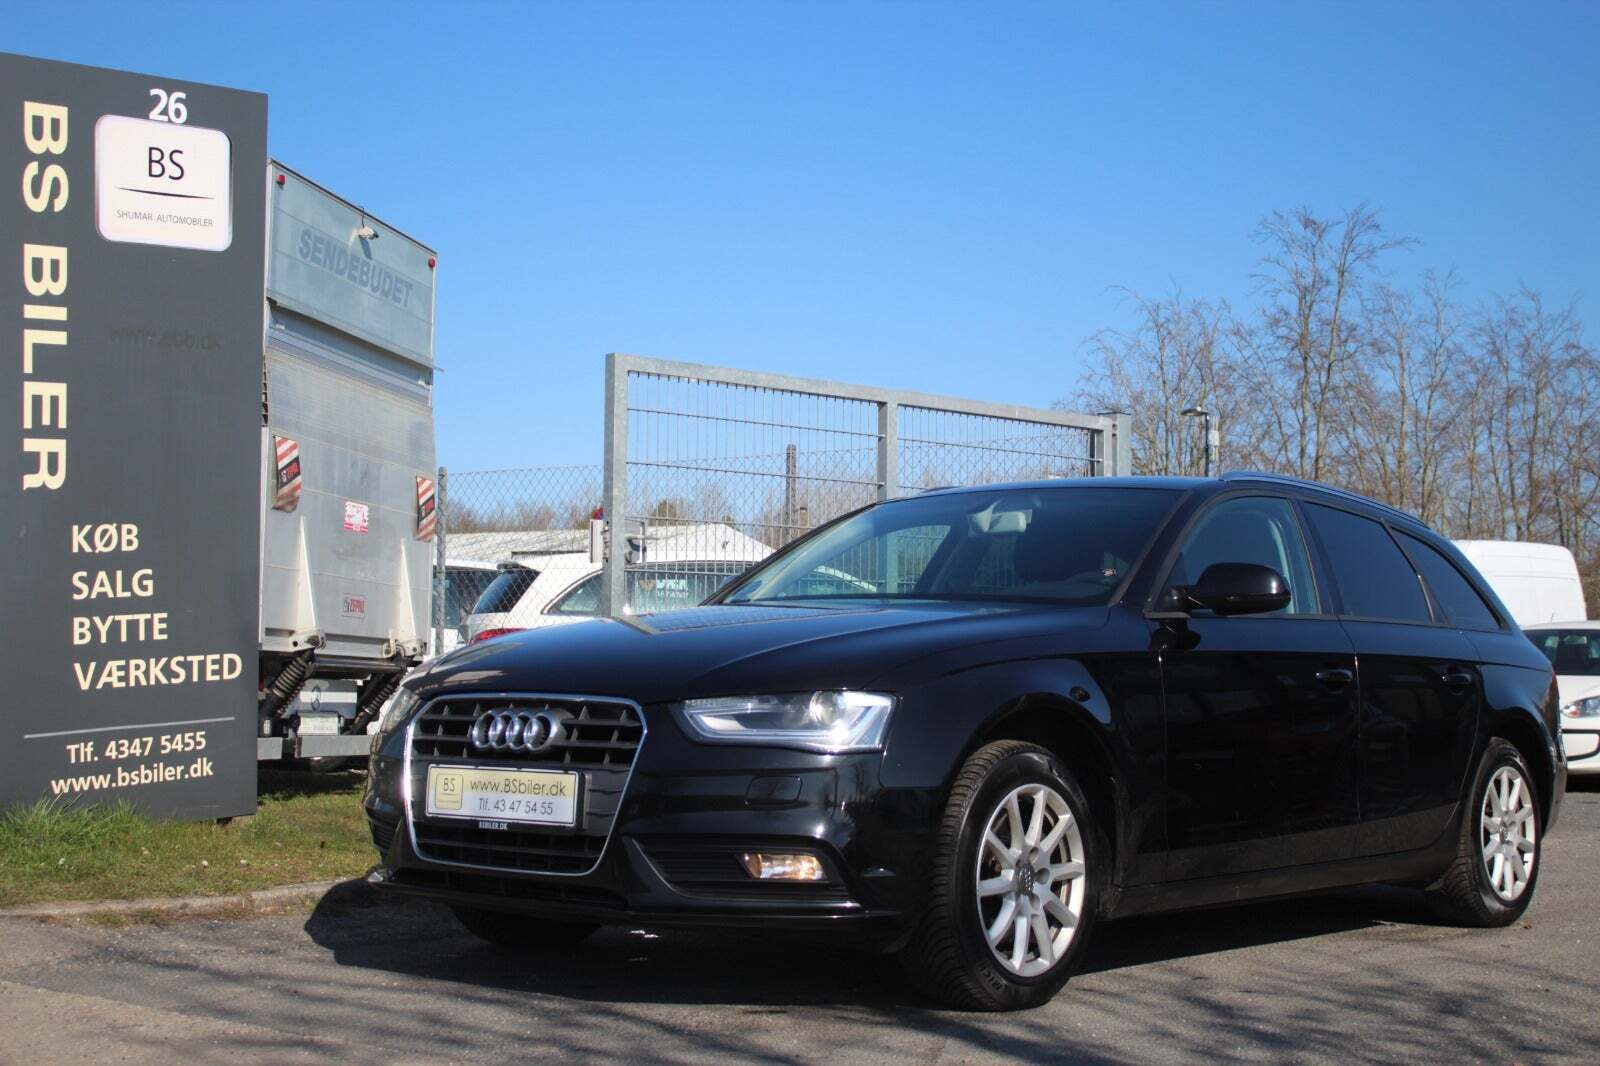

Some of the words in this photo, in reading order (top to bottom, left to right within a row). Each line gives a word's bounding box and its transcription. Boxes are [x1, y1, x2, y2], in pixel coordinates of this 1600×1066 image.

[149, 88, 188, 124] 26
[23, 101, 70, 213] BS
[148, 146, 185, 180] BS
[116, 209, 153, 221] SHUMAR
[157, 214, 214, 227] AUTOMOBILER
[298, 228, 413, 308] SENDEBUDET
[23, 243, 68, 490] BILER
[71, 522, 139, 554] KØB
[71, 569, 154, 600] SALG
[73, 612, 168, 645] BYTTE
[73, 653, 242, 691] VÆRKSTED
[66, 741, 98, 764] Tlf.
[105, 737, 153, 760] 4347
[160, 731, 206, 755] 5455
[51, 757, 213, 795] www.bsbiler.dk
[443, 777, 456, 792] BS
[470, 778, 567, 796] www.BSbiler.dk
[479, 798, 490, 811] Tlf.
[494, 799, 506, 812] 43
[509, 800, 521, 813] 47
[524, 801, 537, 814] 54
[540, 802, 553, 815] 55
